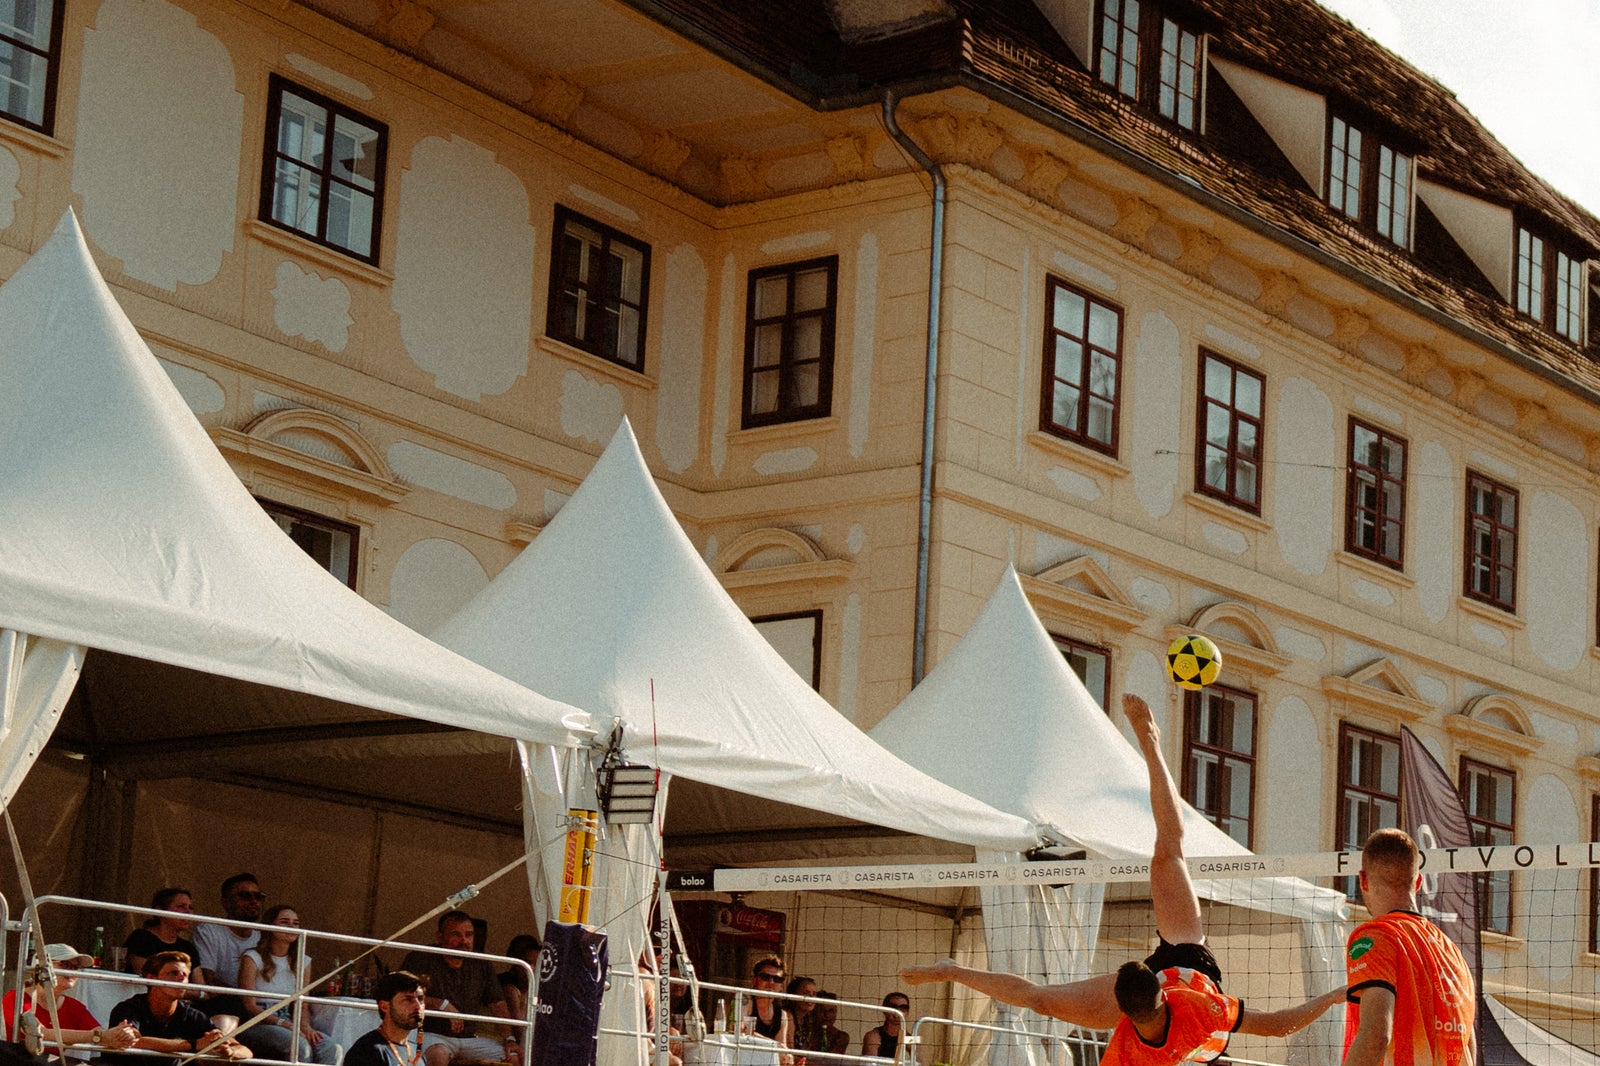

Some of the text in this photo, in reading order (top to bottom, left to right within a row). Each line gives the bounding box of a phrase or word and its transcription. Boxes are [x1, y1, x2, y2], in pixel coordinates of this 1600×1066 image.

[680, 876, 706, 887] bolao
[773, 873, 833, 884] CASARISTA
[854, 871, 915, 883] CASARISTA
[937, 868, 1000, 881] CASARISTA
[1022, 866, 1086, 879] CASARISTA
[1109, 864, 1150, 876] CASAR
[1199, 861, 1267, 873] CASARISTA
